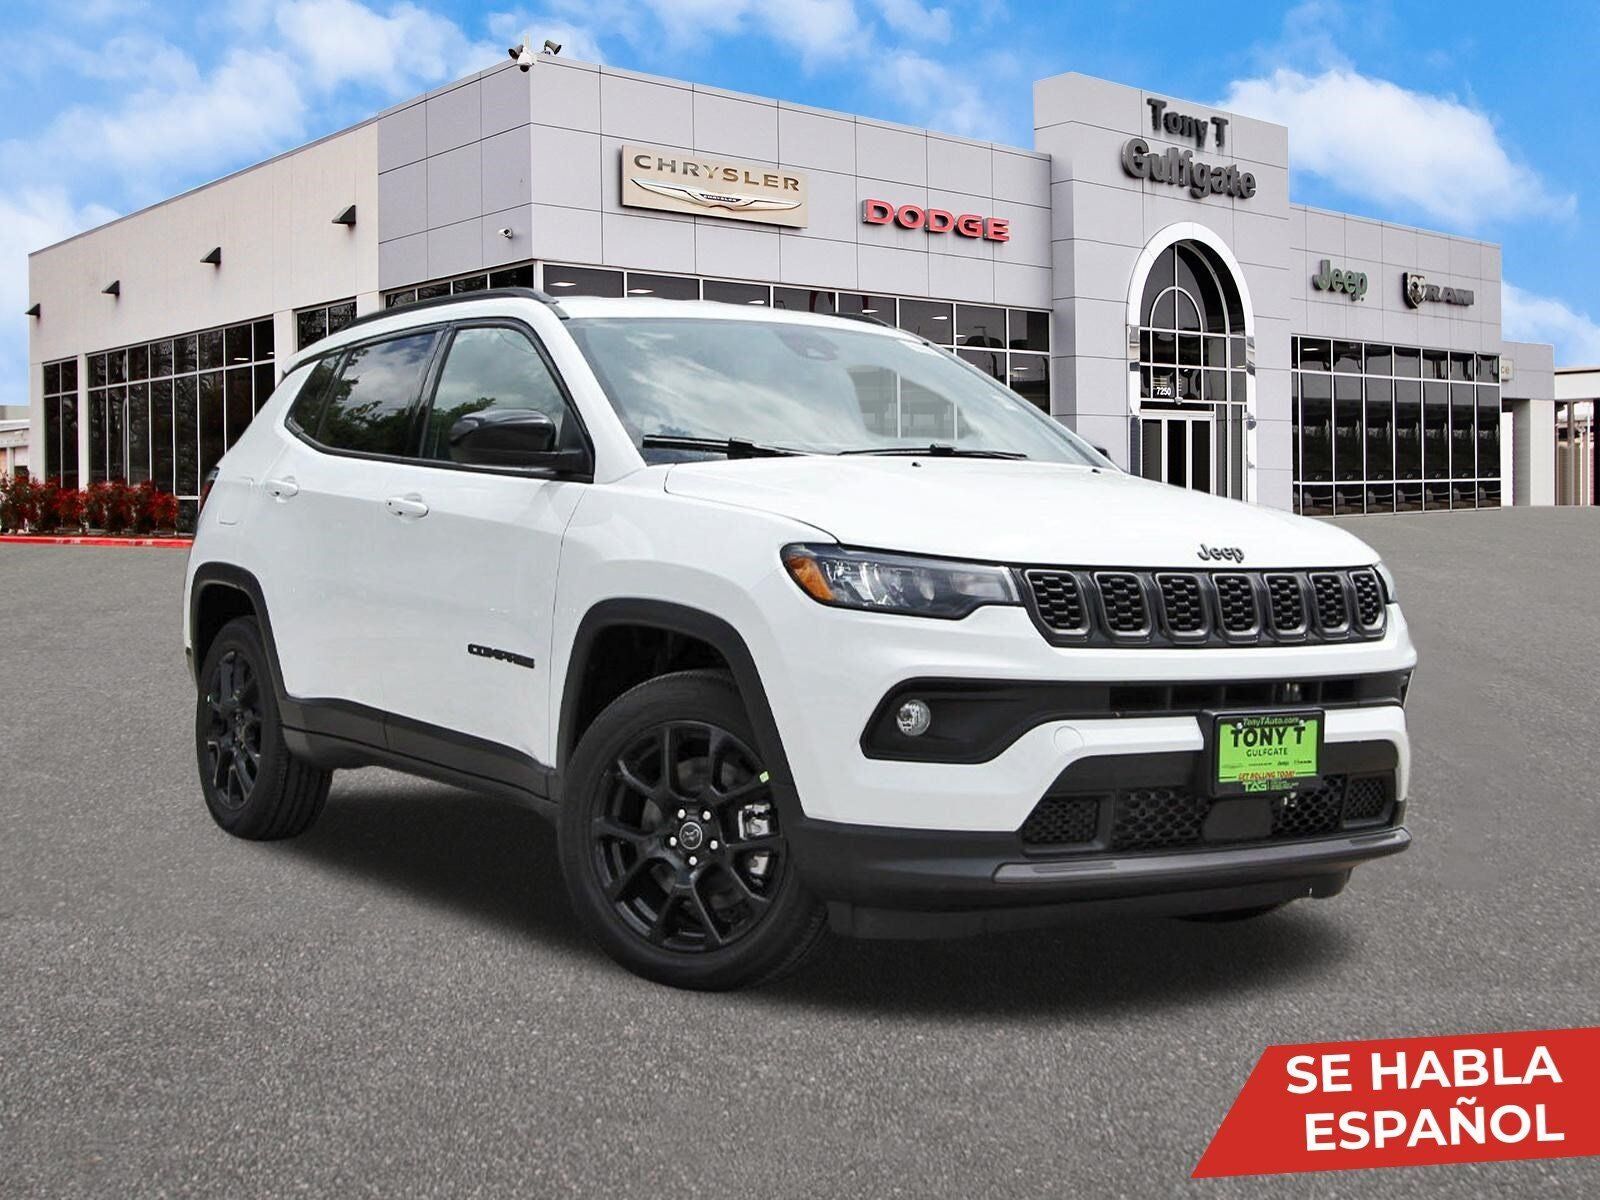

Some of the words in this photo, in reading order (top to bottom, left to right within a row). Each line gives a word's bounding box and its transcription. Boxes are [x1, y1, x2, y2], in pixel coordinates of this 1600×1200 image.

[1146, 98, 1208, 148] Tony
[1211, 116, 1229, 148] T
[633, 154, 800, 192] CHRYSLER
[1121, 138, 1257, 199] Gulfgate
[862, 198, 1010, 243] DODGE
[1312, 259, 1368, 302] Jeep
[1424, 283, 1475, 307] RAM
[1156, 386, 1172, 396] 7250
[1197, 543, 1245, 564] Jeep
[1230, 727, 1288, 748] TONY
[1293, 726, 1306, 745] T
[1246, 748, 1288, 757] GULFGATE
